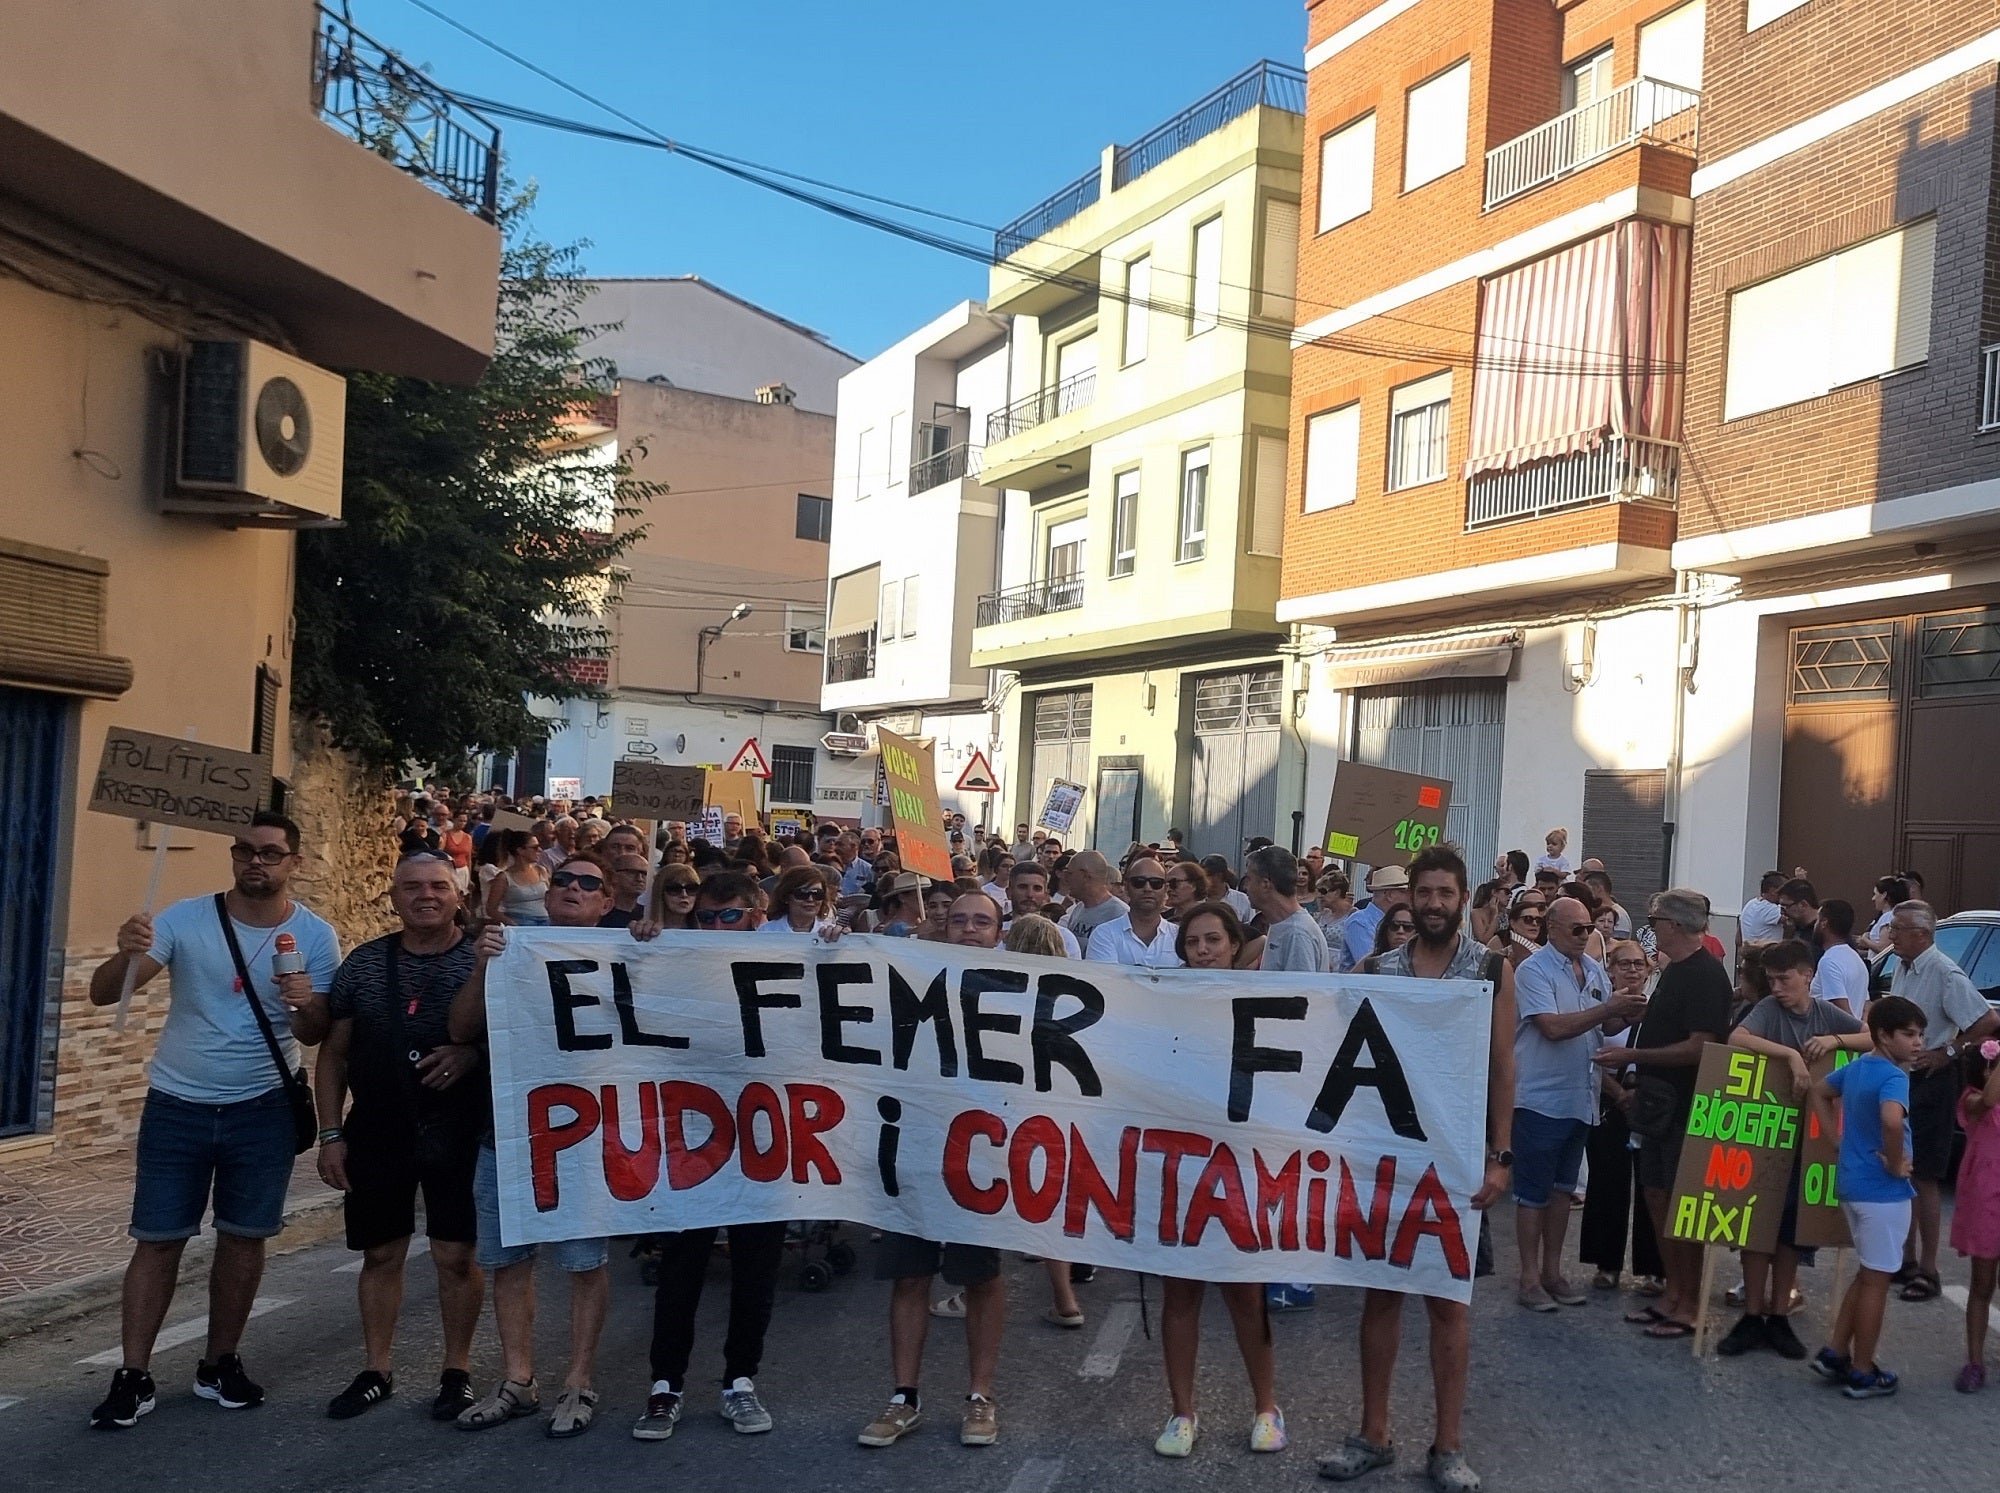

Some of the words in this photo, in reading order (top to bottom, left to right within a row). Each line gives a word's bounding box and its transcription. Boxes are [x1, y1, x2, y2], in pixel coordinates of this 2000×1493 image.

[882, 743, 920, 786] VOLEM
[774, 824, 800, 835] STOP
[893, 787, 927, 828] OBRIR
[545, 958, 690, 1053] EL
[731, 960, 1106, 1098] FEMER
[1227, 995, 1428, 1142] FA
[526, 1080, 847, 1214] PUDOR
[1704, 1145, 1753, 1191] NO
[1804, 1162, 1839, 1208] OL
